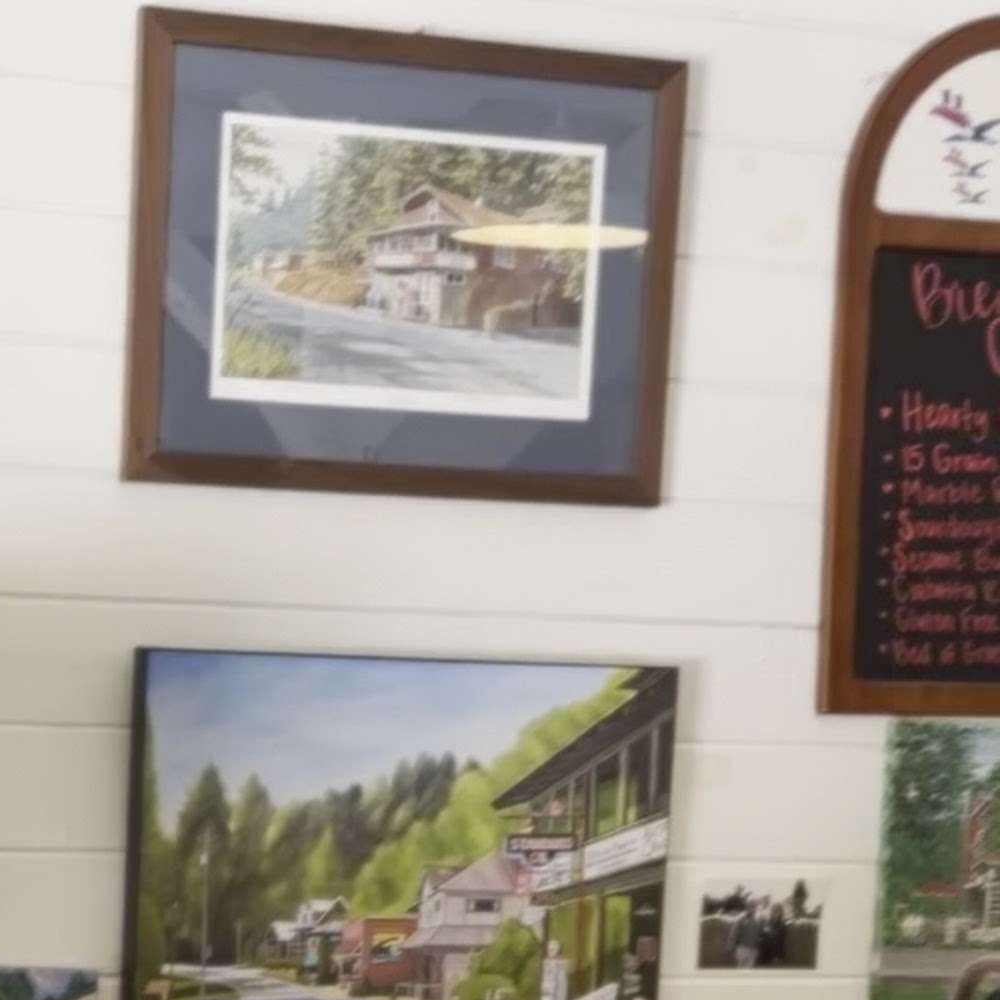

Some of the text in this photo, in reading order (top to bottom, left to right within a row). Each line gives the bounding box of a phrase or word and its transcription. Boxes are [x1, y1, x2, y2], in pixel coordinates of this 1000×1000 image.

[911, 261, 1000, 330] Bre
[902, 389, 990, 443] Hearty
[902, 443, 926, 472] 15
